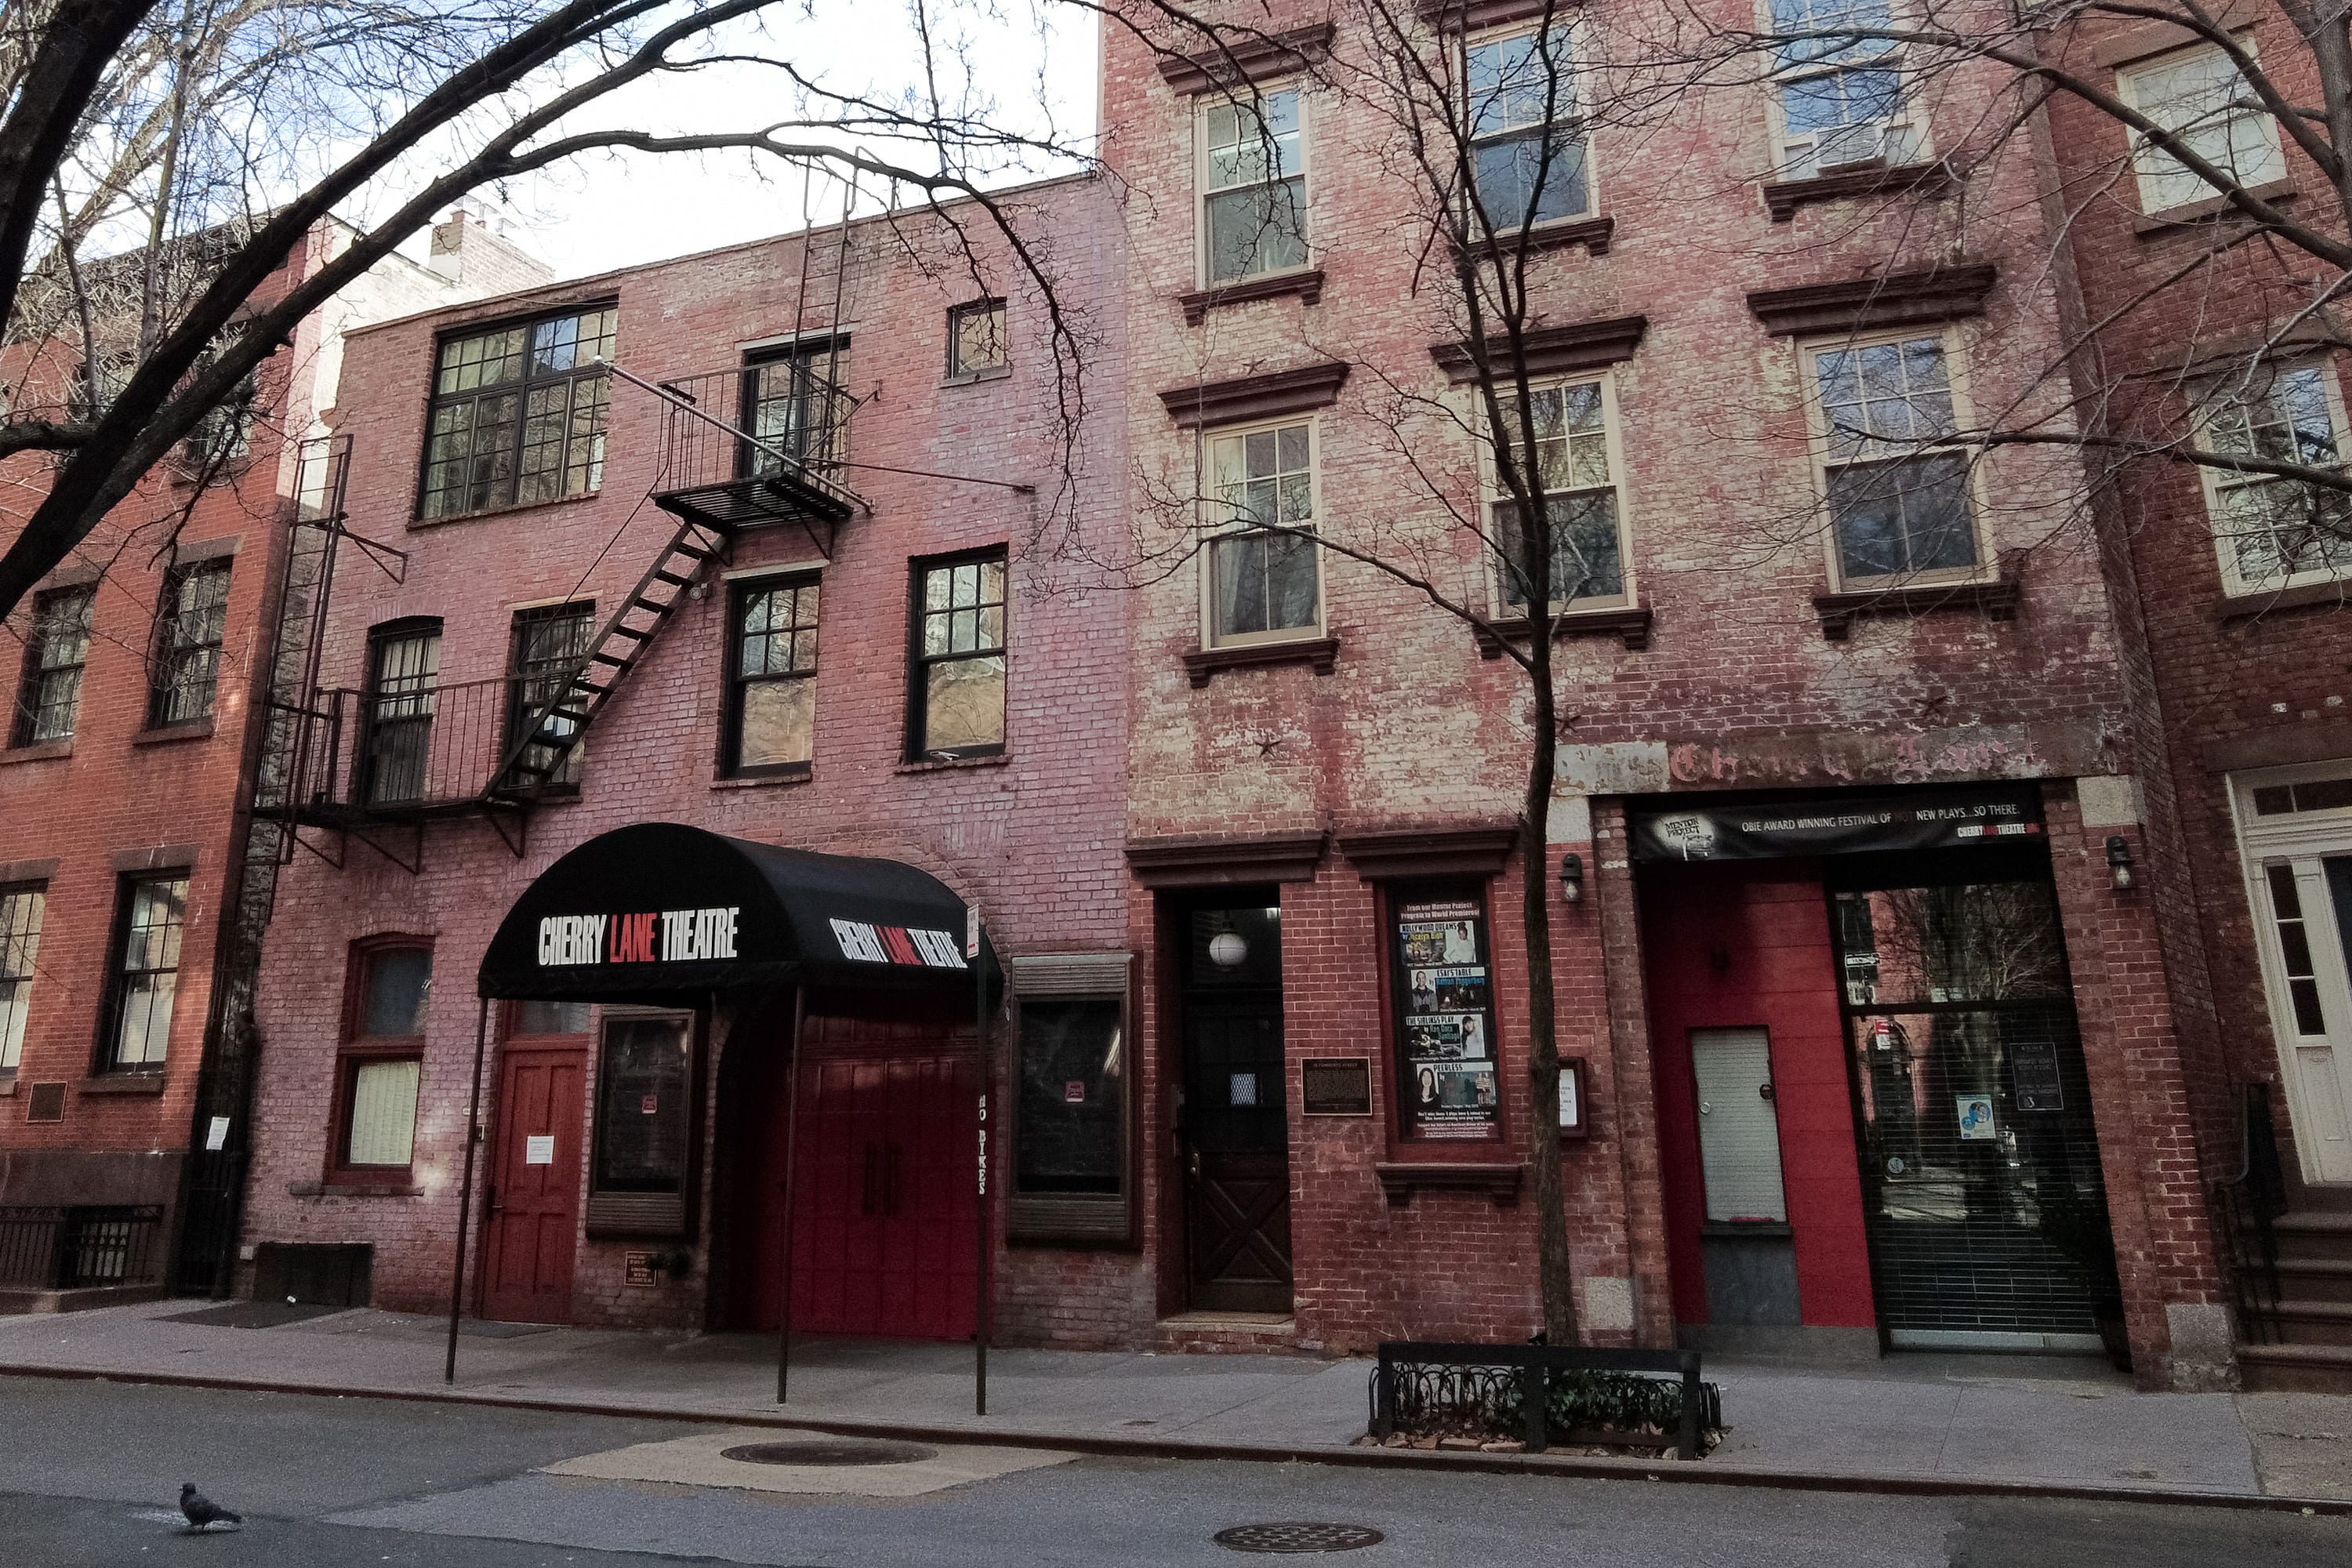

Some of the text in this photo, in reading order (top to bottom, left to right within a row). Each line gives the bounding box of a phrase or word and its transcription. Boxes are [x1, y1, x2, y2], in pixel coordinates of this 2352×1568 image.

[1664, 817, 1700, 830] MENTOR
[1668, 826, 1700, 838] PROJECT
[1741, 821, 1762, 833] OBIE
[1763, 818, 1795, 832] AWARD
[1797, 818, 1836, 829] WINNING
[1838, 813, 1878, 828] FESTIVAL
[1880, 812, 1892, 824] OF
[1915, 808, 1936, 822] NEW
[1988, 804, 2020, 816] THERE.
[538, 907, 739, 966] CHERRY LANE THEATRE
[829, 917, 968, 969] CHERRY LANE THEATRE
[978, 1129, 987, 1196] BIKES
